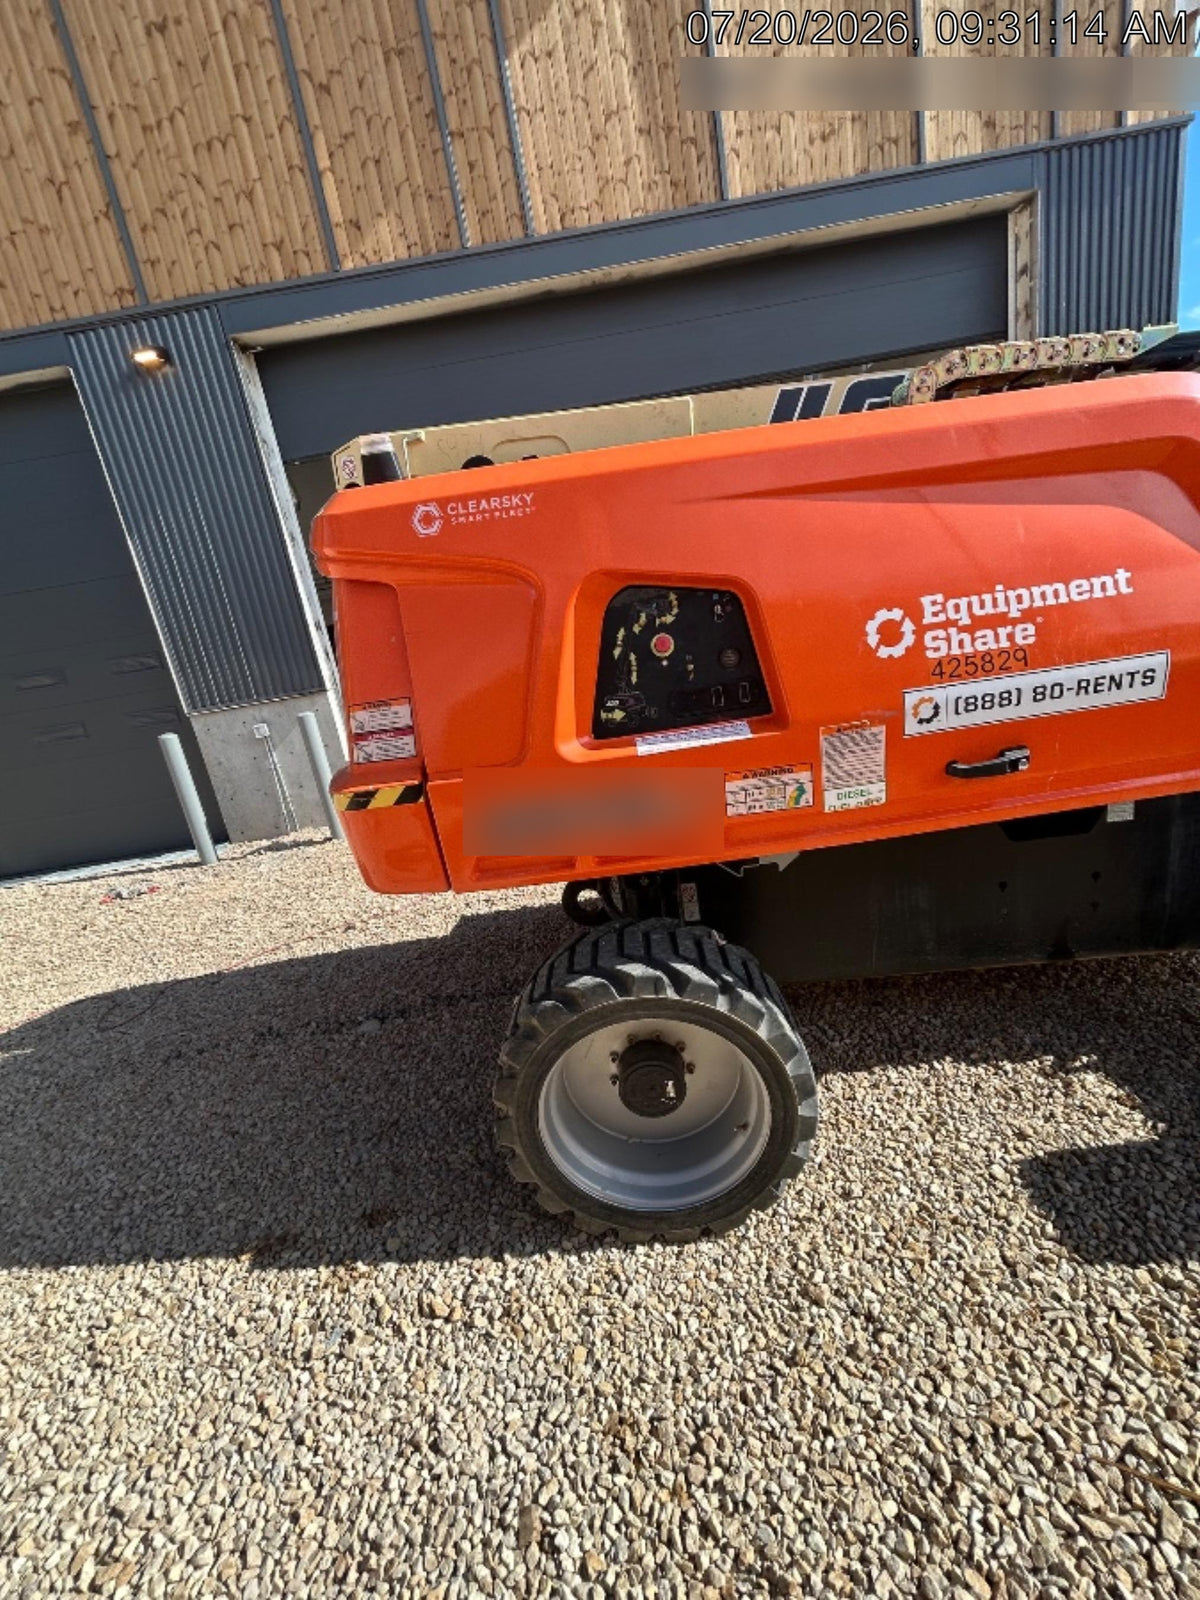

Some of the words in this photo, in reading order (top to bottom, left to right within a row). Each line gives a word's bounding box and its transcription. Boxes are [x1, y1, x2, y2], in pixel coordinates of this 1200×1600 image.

[447, 492, 534, 515] CLEARSKY
[920, 568, 1133, 625] Equipment
[923, 621, 1036, 659] Share
[931, 648, 1029, 680] 425829
[954, 688, 1023, 716] (888)
[1032, 668, 1157, 703] 80-RENTS
[837, 788, 873, 801] DIESEL
